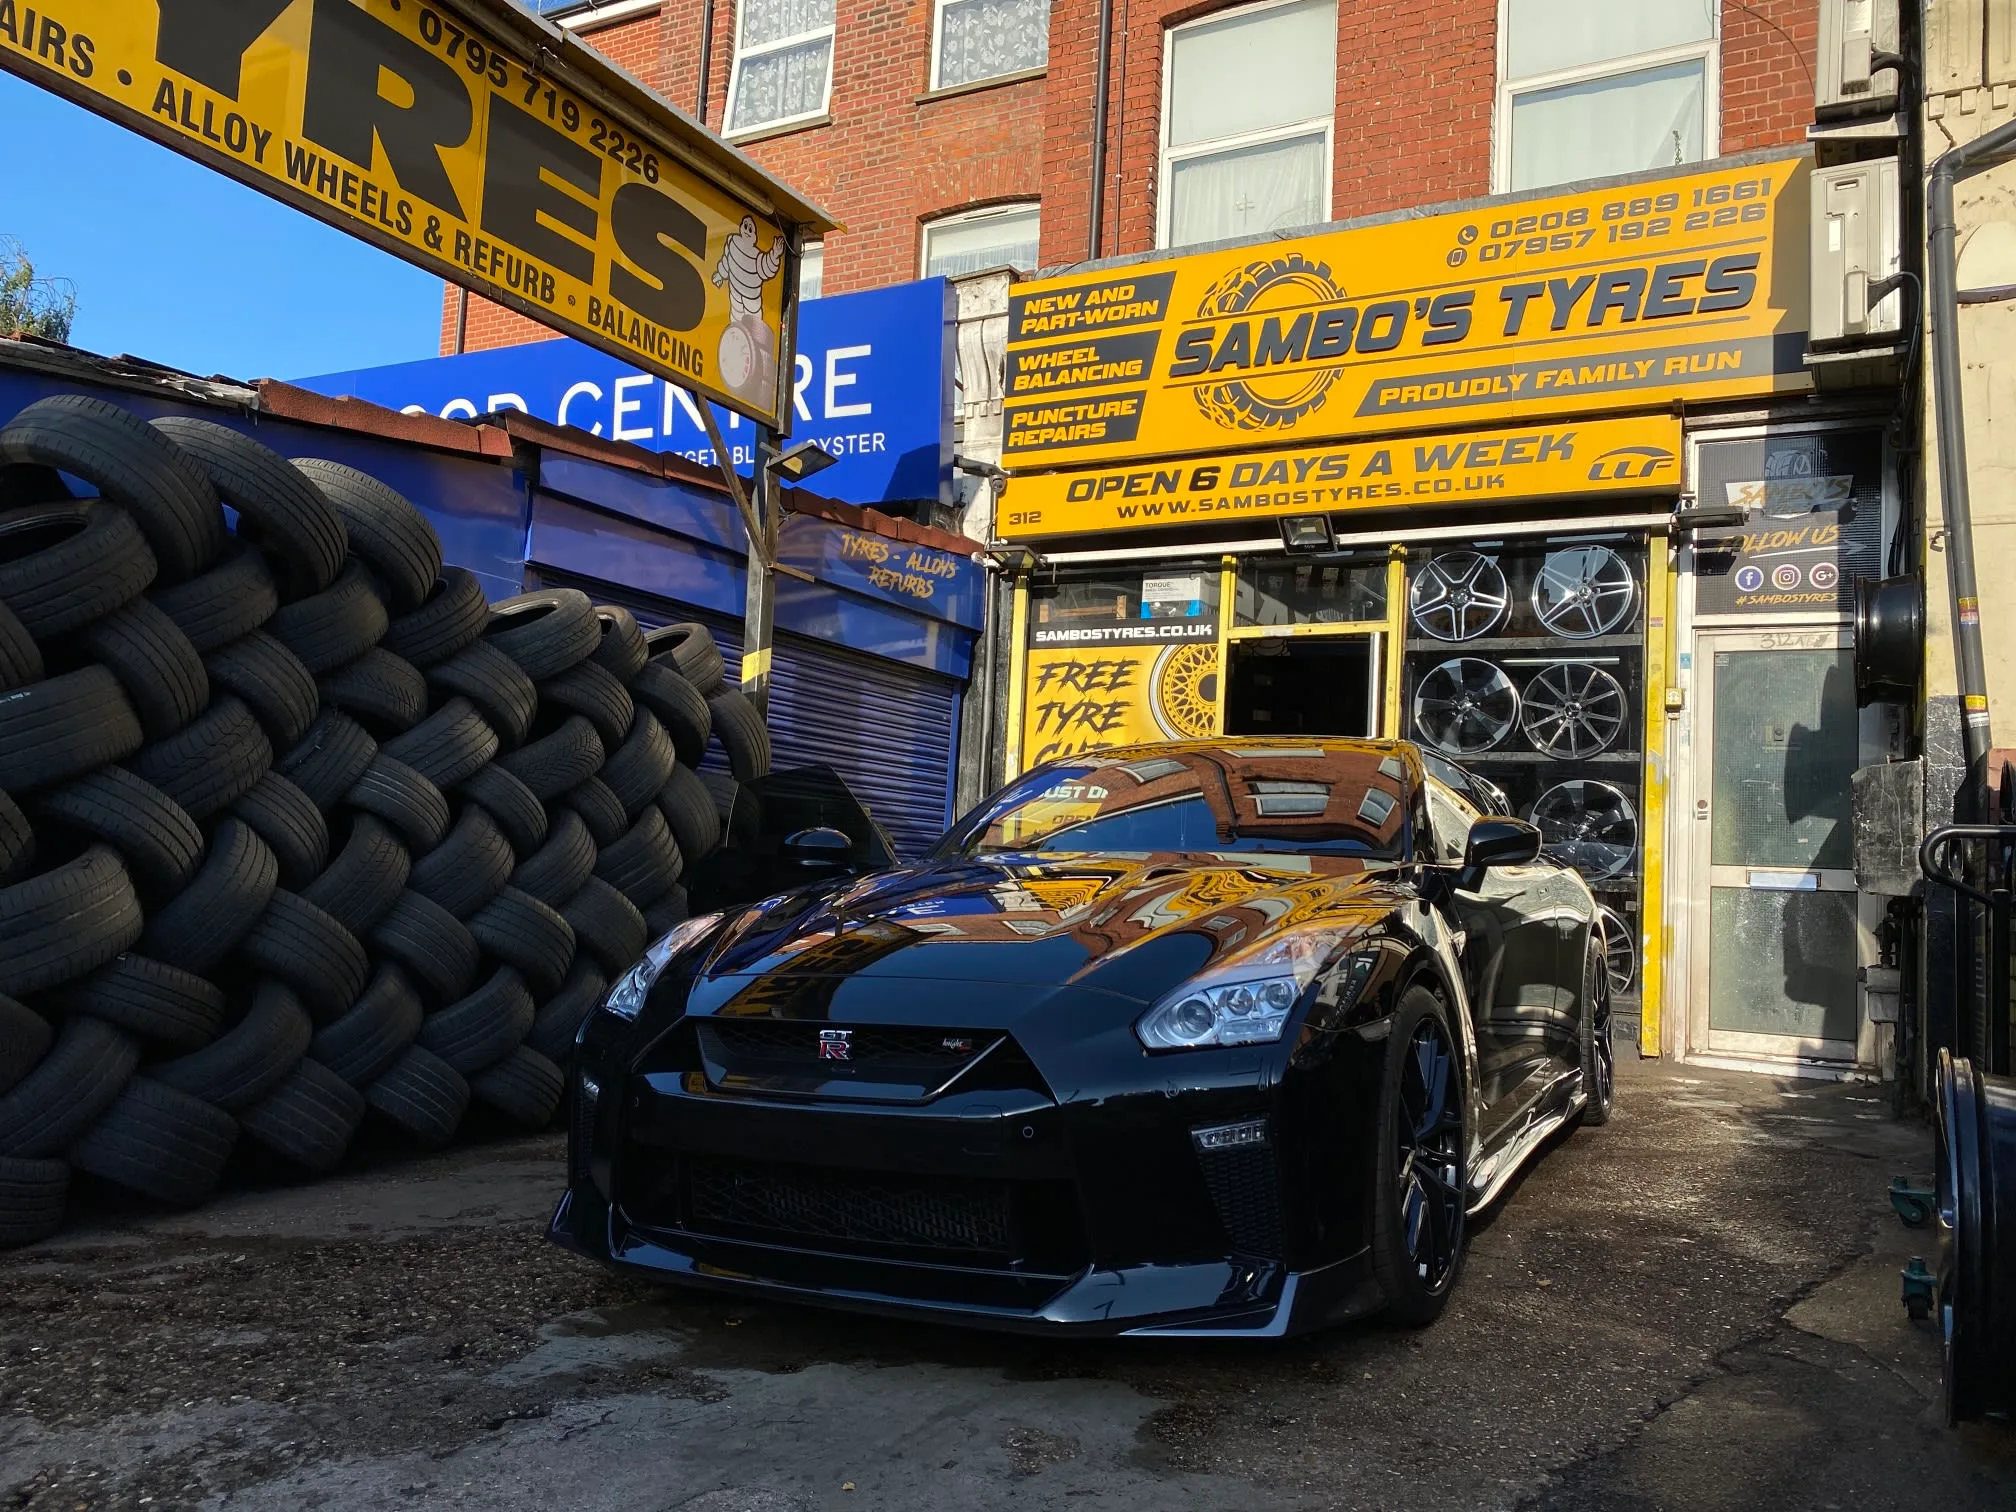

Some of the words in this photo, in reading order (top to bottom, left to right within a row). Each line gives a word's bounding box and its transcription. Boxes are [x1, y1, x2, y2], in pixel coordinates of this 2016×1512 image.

[418, 9, 508, 89] 0795
[521, 71, 580, 133] 719
[590, 118, 660, 184] 2226
[152, 77, 272, 164] ALLOY
[284, 139, 412, 236] WHEELS
[423, 215, 442, 253] &
[454, 229, 555, 304] REFURB
[587, 296, 704, 377] BALANCING
[1490, 207, 1589, 239] 0208
[1601, 193, 1680, 222] 889
[1692, 178, 1772, 207] 1661
[1479, 228, 1597, 262] 07957
[1608, 217, 1671, 243] 192
[1684, 202, 1767, 232] 226
[1021, 300, 1159, 334] PART-WORN
[1024, 293, 1082, 316] NEW
[1085, 284, 1135, 306] AND
[1168, 290, 1475, 379] SAMBO'S
[1499, 252, 1762, 338] TYRES
[1013, 359, 1143, 391] BALANCING
[1018, 346, 1100, 371] WHEEL
[1378, 373, 1527, 406] PROUDLY
[1535, 359, 1656, 389] FAMILY
[1663, 350, 1743, 377] RUN
[557, 344, 872, 441] CENRE
[1011, 398, 1138, 428] PUNCTURE
[1008, 422, 1106, 447] REPAIRS
[1066, 468, 1182, 503] OPEN
[1189, 466, 1222, 492] 6
[1229, 454, 1349, 489] DAYS
[1359, 449, 1393, 478] A
[1413, 431, 1580, 473] WEEK
[1117, 473, 1505, 519] WWW.SAMBOSTYRES.CO.UK
[1008, 511, 1042, 526] 312
[1812, 524, 1840, 545] US
[842, 533, 889, 564] TYRES
[906, 552, 957, 579] ALLOYS
[868, 566, 934, 599] REFURBS
[1735, 592, 1838, 606] #SAMBOSTYRES
[1035, 624, 1212, 642] SAMBOSTYRES.CO.UK
[1035, 655, 1142, 696] FREE
[1035, 697, 1134, 739] TYRE
